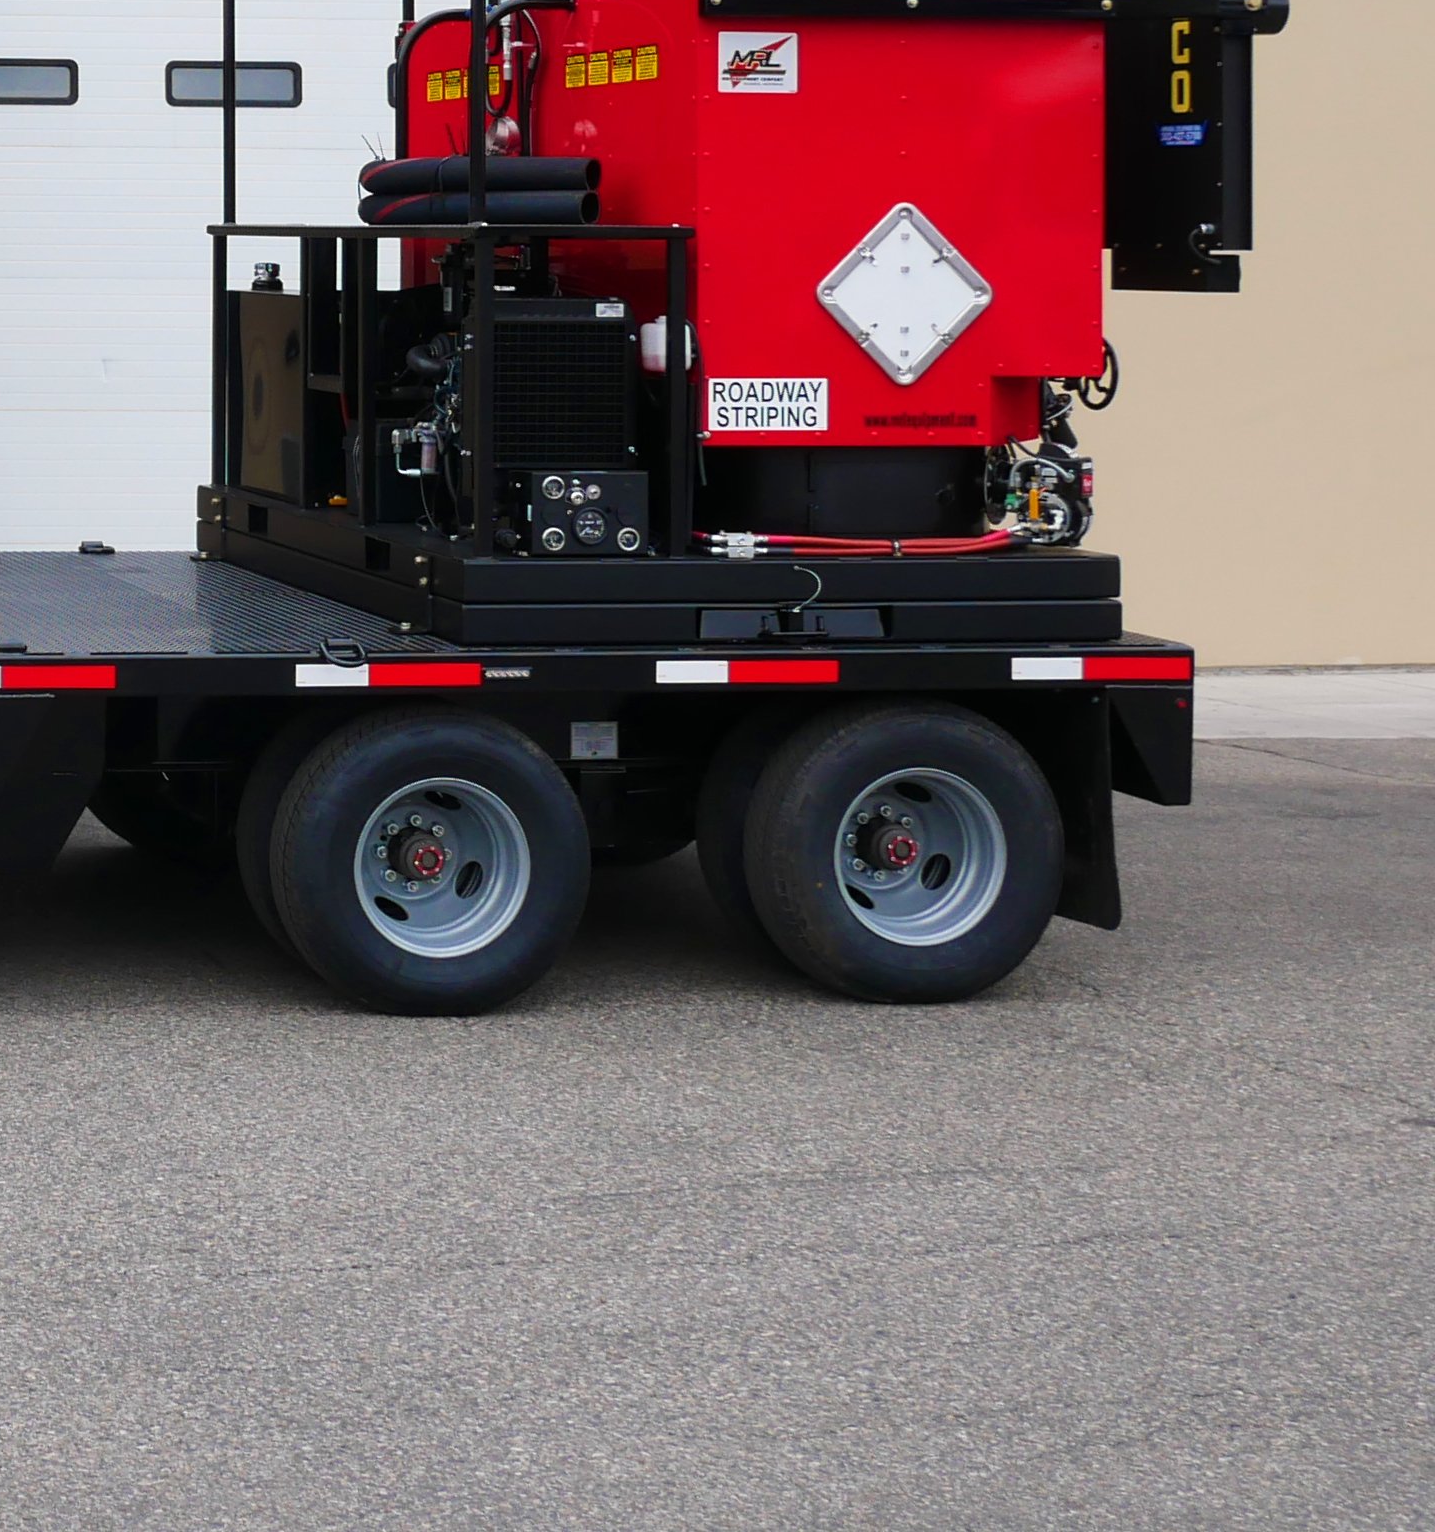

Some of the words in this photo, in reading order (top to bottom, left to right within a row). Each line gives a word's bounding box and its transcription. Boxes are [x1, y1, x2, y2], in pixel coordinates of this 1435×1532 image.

[729, 50, 781, 68] MRL
[712, 382, 822, 402] ROADWAY
[717, 406, 817, 427] STRIPING
